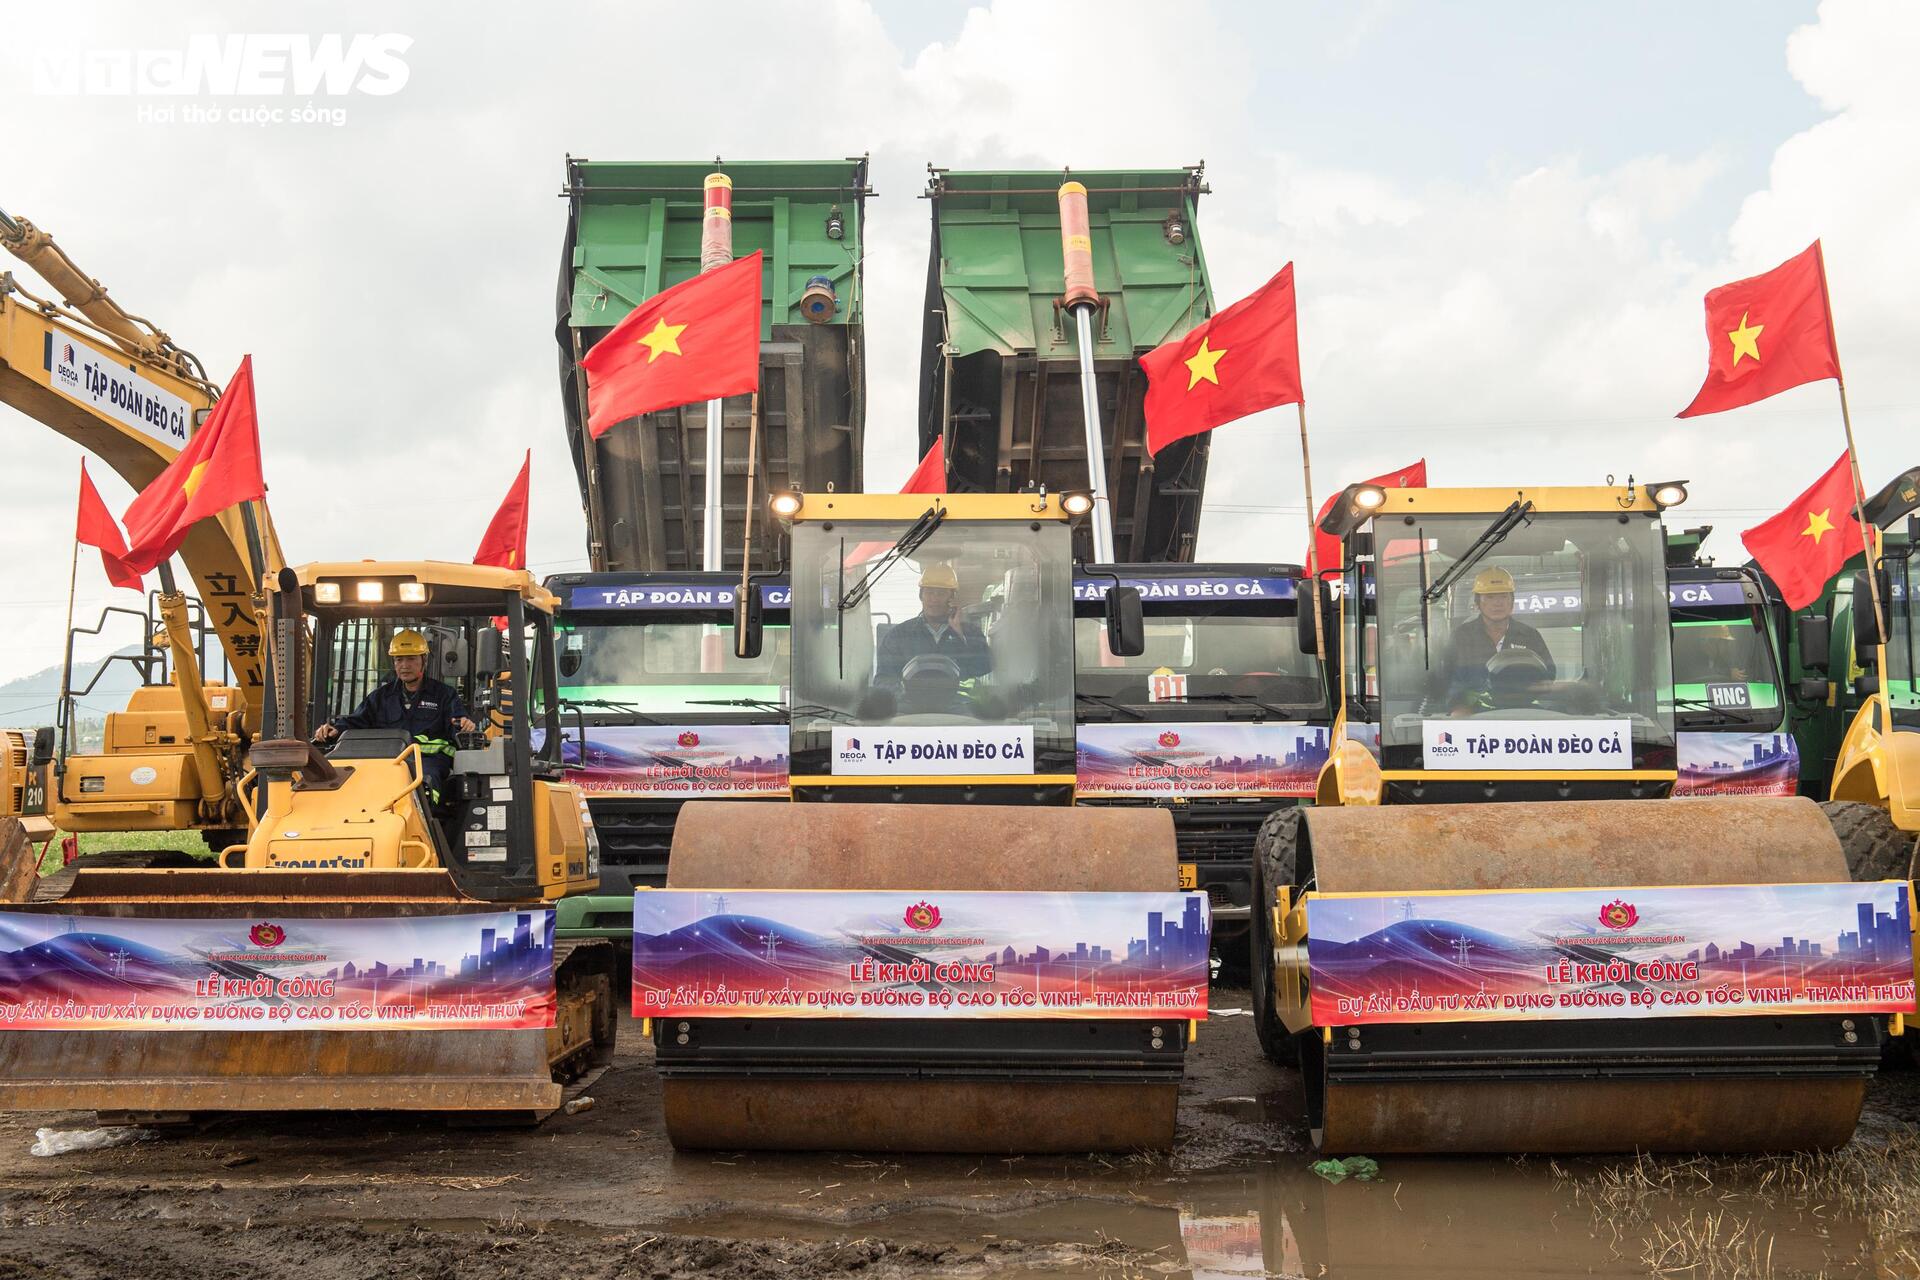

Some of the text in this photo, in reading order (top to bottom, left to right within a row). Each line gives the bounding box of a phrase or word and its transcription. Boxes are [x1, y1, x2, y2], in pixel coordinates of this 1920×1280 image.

[58, 364, 79, 383] DEOCA
[84, 362, 185, 440] TẬP ĐOÀN ĐÈO CẢ
[603, 589, 645, 607] TẬP
[651, 589, 711, 604] ĐOÀN
[1137, 582, 1179, 597] OÀN
[1185, 581, 1229, 596] ĐÈO
[1234, 579, 1264, 596] CẢ
[1514, 594, 1557, 613] TẬP
[1682, 586, 1713, 602] CẢ
[1712, 687, 1746, 706] HNC
[874, 737, 1025, 764] TẬP ĐOÀN ĐÈO CẢ
[1466, 731, 1622, 758] TẬP ĐOÀN ĐÈO CẢ
[695, 764, 730, 778] CÔNG
[1177, 764, 1212, 777] CÔNG
[28, 787, 43, 805] 210
[708, 782, 729, 791] CAO
[757, 781, 779, 791] VINH
[1190, 781, 1212, 790] CAO
[1237, 781, 1260, 790] VINH
[1268, 781, 1299, 791] THANH
[1693, 787, 1717, 797] VINH
[1725, 786, 1757, 796] THANH
[850, 957, 995, 982] LỄ KHỞI CÔNG
[1546, 957, 1699, 984] LỄ KHỞI CÔNG
[195, 972, 335, 997] LỄ KHỞI CÔNG
[645, 988, 670, 1009] DỰ
[673, 986, 698, 1005] ÁN
[702, 984, 738, 1005] ĐẦU
[742, 988, 765, 1005] TƯ
[768, 987, 803, 1005] XÂY
[807, 988, 856, 1010] DỰNG
[860, 988, 924, 1006] ĐƯỜNG
[928, 988, 953, 1010] BỘ
[957, 991, 996, 1006] CAO
[1000, 986, 1036, 1006] TỐC
[1038, 991, 1081, 1007] VINH
[1095, 991, 1152, 1007] THANH
[1156, 987, 1199, 1007] THUỶ
[1338, 997, 1363, 1017] DỰ
[1367, 993, 1392, 1013] ÁN
[1396, 990, 1434, 1011] ĐẦU
[1436, 994, 1459, 1011] TƯ
[1463, 992, 1499, 1010] XÂY
[1503, 993, 1554, 1013] DỰNG
[1559, 989, 1625, 1008] ĐƯỜNG
[1630, 988, 1656, 1010] BỘ
[1660, 990, 1701, 1006] CAO
[1705, 983, 1743, 1005] TỐC
[1747, 987, 1792, 1004] VINH
[1806, 986, 1868, 1002] THANH
[1872, 980, 1916, 1001] THUỶ
[22, 1001, 47, 1019] ÁN
[51, 999, 86, 1019] ĐẦU
[90, 1004, 112, 1019] TƯ
[113, 1001, 149, 1019] XÂY
[151, 1004, 200, 1022] DỰNG
[203, 1005, 264, 1020] ĐƯỜNG
[268, 1003, 292, 1023] BỘ
[296, 1006, 333, 1020] CAO
[338, 1000, 372, 1020] TỐC
[376, 1005, 416, 1019] VINH
[428, 1004, 482, 1019] THANH
[486, 999, 526, 1018] THUỶ
